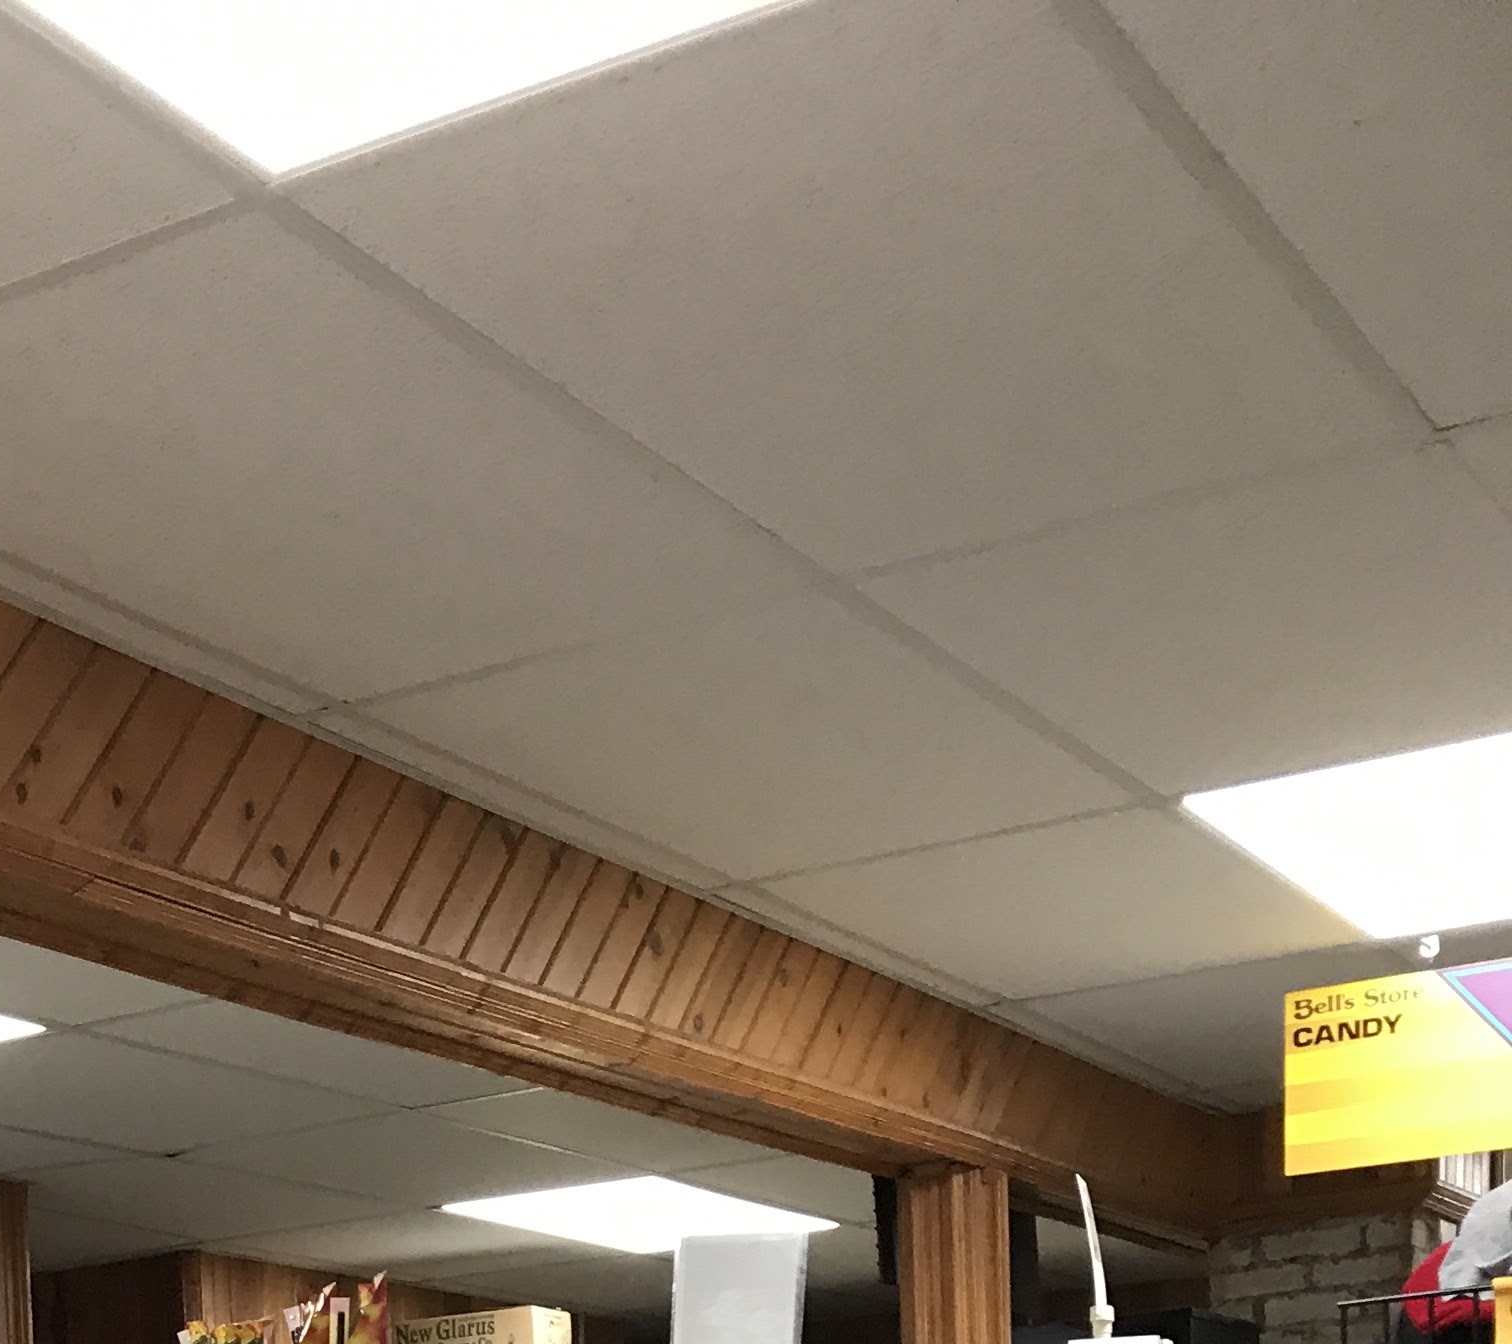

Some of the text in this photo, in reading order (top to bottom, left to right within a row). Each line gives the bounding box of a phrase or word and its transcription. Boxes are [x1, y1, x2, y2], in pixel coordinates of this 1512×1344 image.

[1293, 993, 1355, 1020] Bell's
[1293, 1013, 1403, 1048] CANDY
[436, 1317, 497, 1341] Glarus
